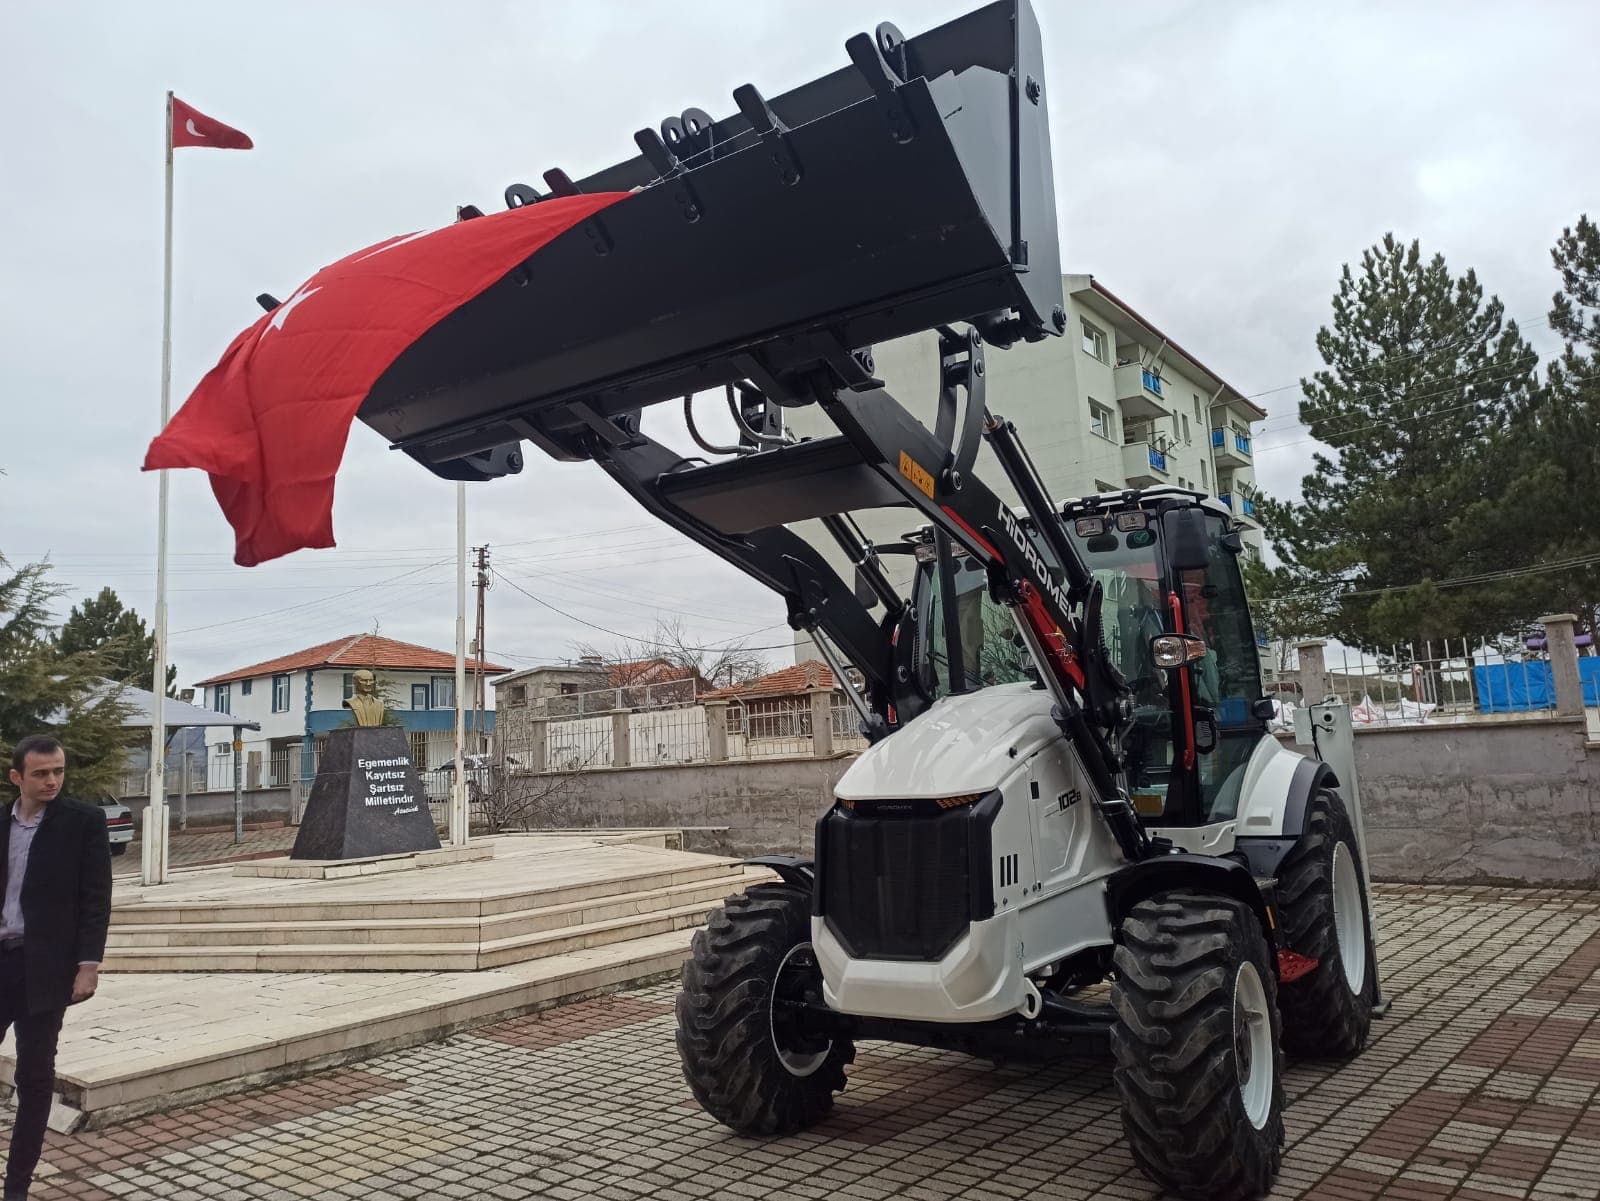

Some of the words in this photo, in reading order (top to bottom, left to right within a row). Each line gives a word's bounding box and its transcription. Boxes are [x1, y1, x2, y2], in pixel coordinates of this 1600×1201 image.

[358, 756, 409, 769] Egemenlik
[365, 771, 406, 781] Kayıtsız
[369, 783, 405, 795] Şartsız
